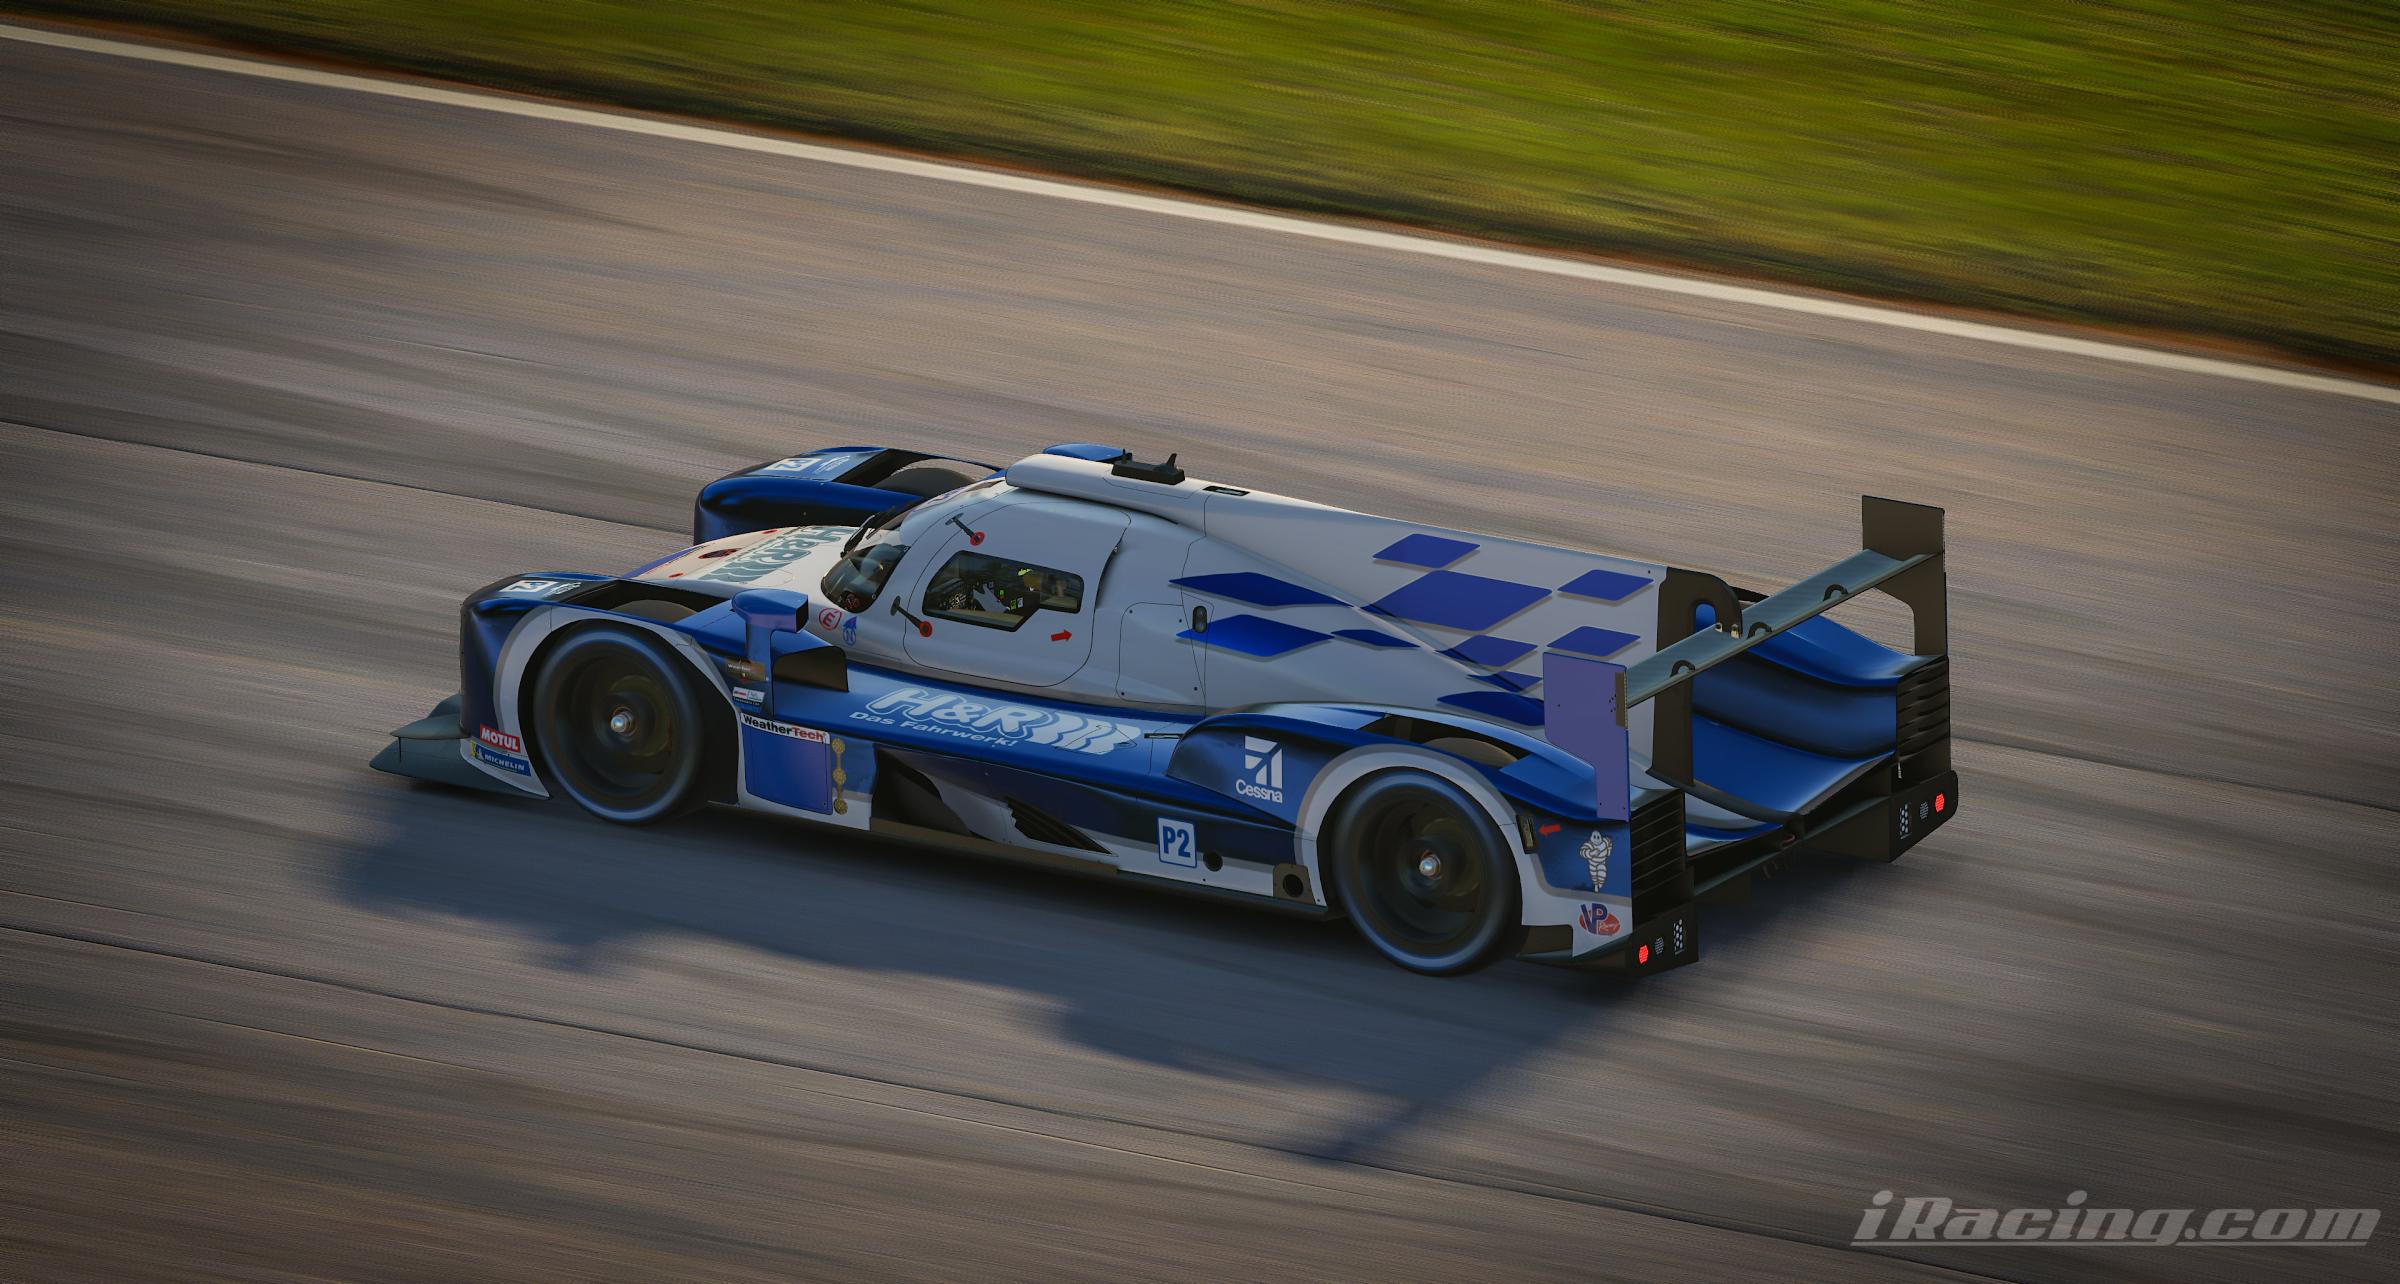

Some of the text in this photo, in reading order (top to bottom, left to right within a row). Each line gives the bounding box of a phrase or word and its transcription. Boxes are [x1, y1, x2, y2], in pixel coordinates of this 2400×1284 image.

[742, 714, 825, 742] WeatherTech
[866, 687, 1052, 739] H&R
[481, 726, 519, 751] MOTUL
[849, 711, 1018, 748] Das Fahrwerk!
[484, 753, 525, 771] MICHELIN
[1235, 778, 1283, 804] Cessna
[1162, 825, 1191, 858] P2
[1580, 902, 1608, 934] VP
